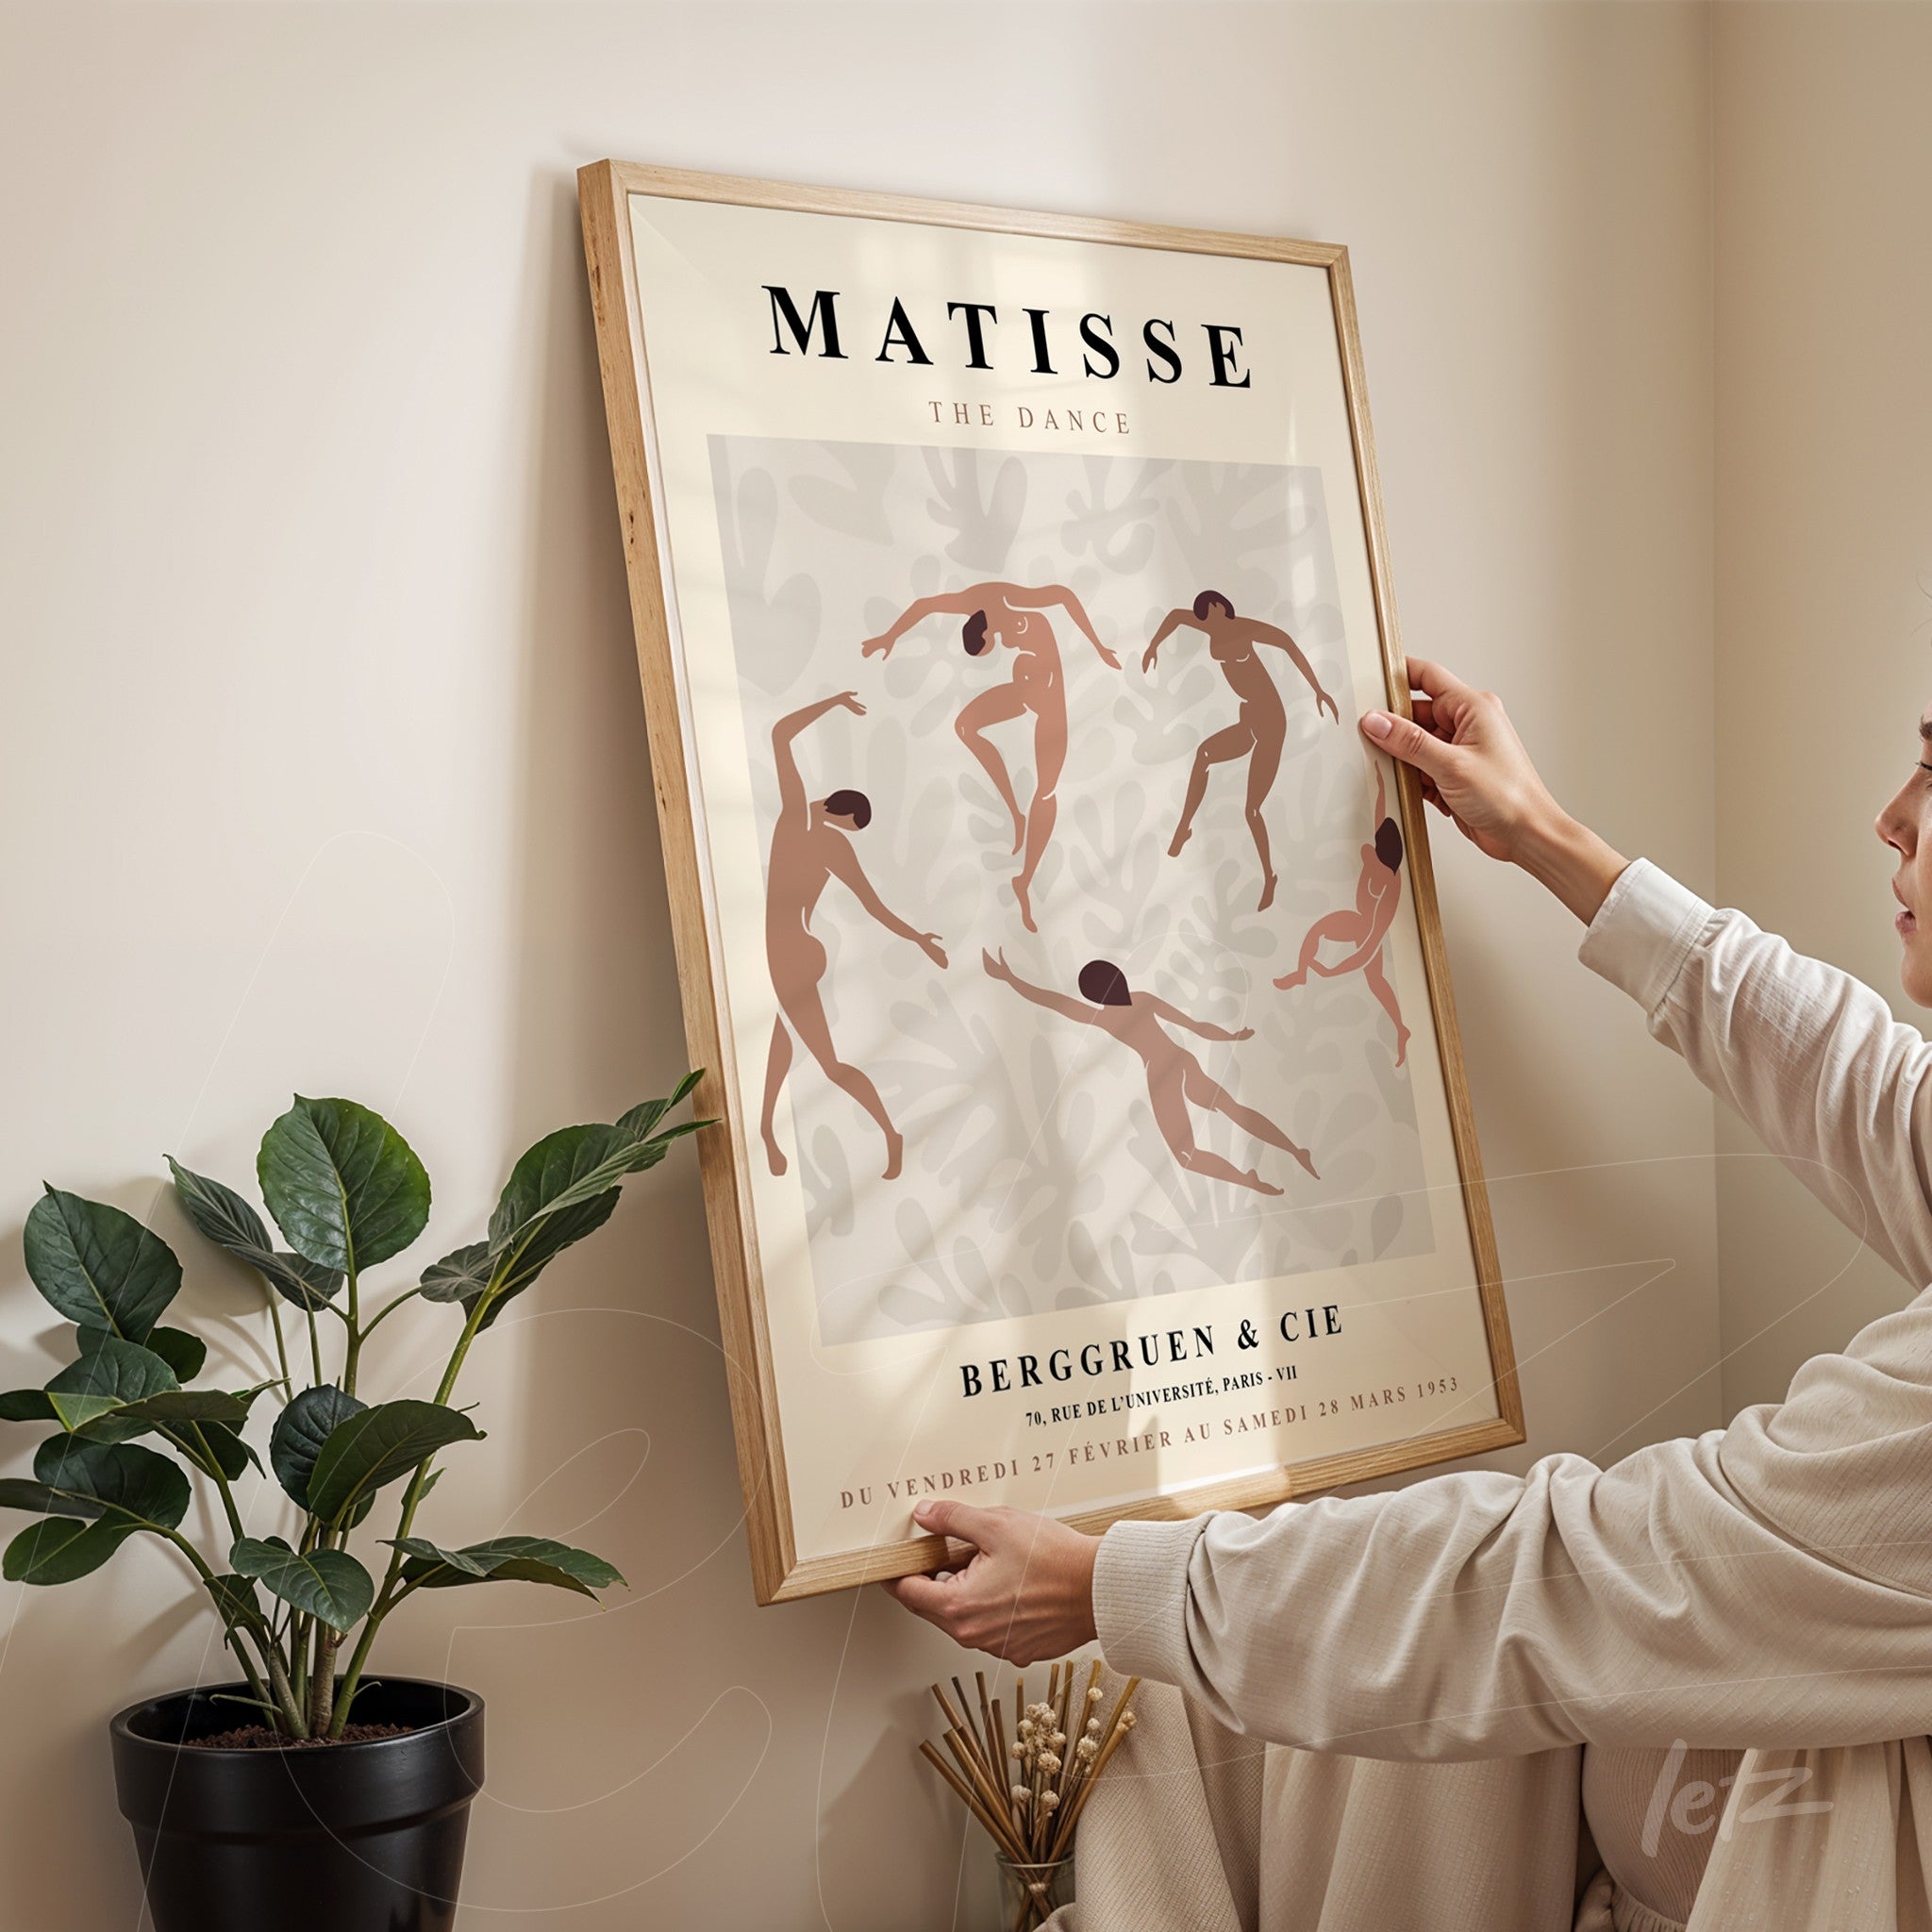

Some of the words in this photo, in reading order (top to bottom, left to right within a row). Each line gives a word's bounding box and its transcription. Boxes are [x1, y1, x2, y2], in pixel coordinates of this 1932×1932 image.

[761, 285, 1251, 389] MATISSE
[928, 400, 995, 427] THE
[1017, 406, 1130, 435] DANCE
[959, 1324, 1215, 1398] BERGGRUEN
[1237, 1318, 1259, 1351] &
[1279, 1304, 1342, 1342] CIE
[1025, 1411, 1047, 1427] 70,
[1051, 1403, 1082, 1424] RUE
[1087, 1398, 1108, 1418] DE
[1223, 1371, 1264, 1393] PARIS
[1275, 1365, 1298, 1382] VII
[840, 1486, 874, 1509] DU
[887, 1458, 1020, 1500] VENDREDI
[1031, 1452, 1056, 1473] 27
[1068, 1429, 1172, 1466] FÉVRIER
[1183, 1423, 1211, 1444] AU
[1224, 1405, 1308, 1436] SAMEDI
[1318, 1399, 1340, 1417] 28
[1350, 1385, 1407, 1412] MARS
[1416, 1376, 1459, 1399] 1953
